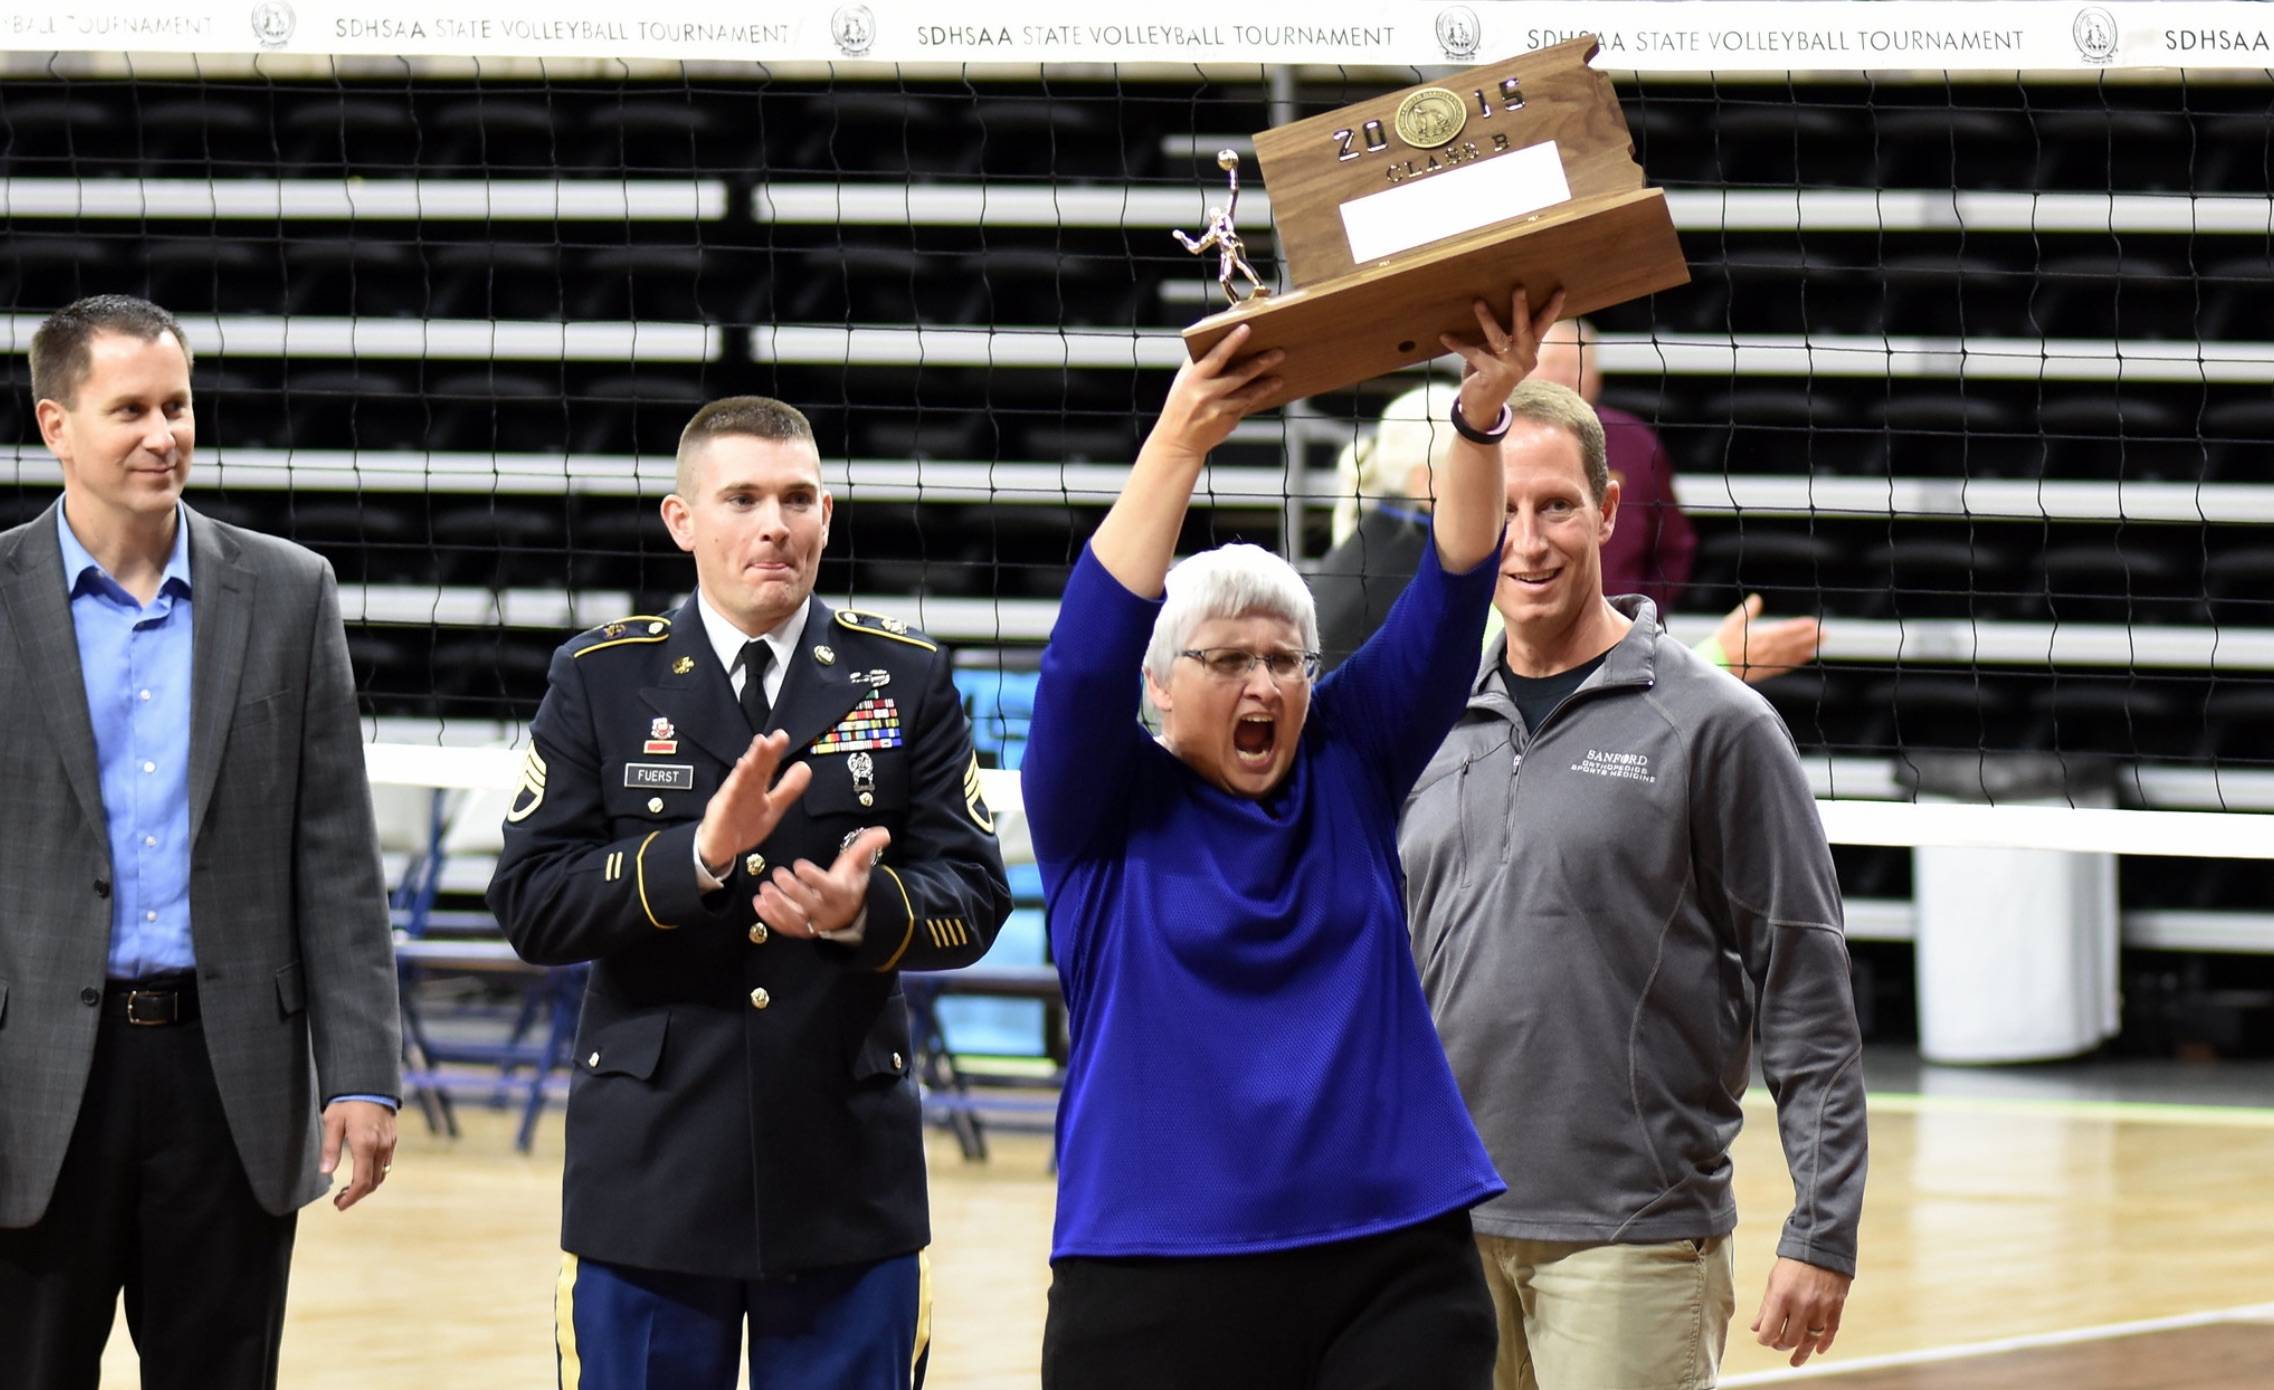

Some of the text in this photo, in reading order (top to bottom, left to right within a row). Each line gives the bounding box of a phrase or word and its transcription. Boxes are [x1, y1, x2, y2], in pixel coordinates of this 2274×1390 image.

[335, 18, 789, 44] SDHSAA STATE VOLLEYBALL TOURNAMENT
[917, 25, 1396, 47] SDHSAA STATE VOLLEYBALL TOURNAMENT
[1635, 31, 1700, 51] STATE
[1708, 30, 1850, 51] VOLLEYBALL
[1857, 30, 2024, 51] TOURNAMENT
[2164, 29, 2270, 51] SDHSAA
[1386, 133, 1510, 183] CLASS B
[1582, 760, 1648, 775] ORTHOPEDICS
[1586, 748, 1648, 766] SANFORD
[637, 769, 680, 783] FUERST
[1570, 764, 1656, 783] SPORTS MEDICINE
